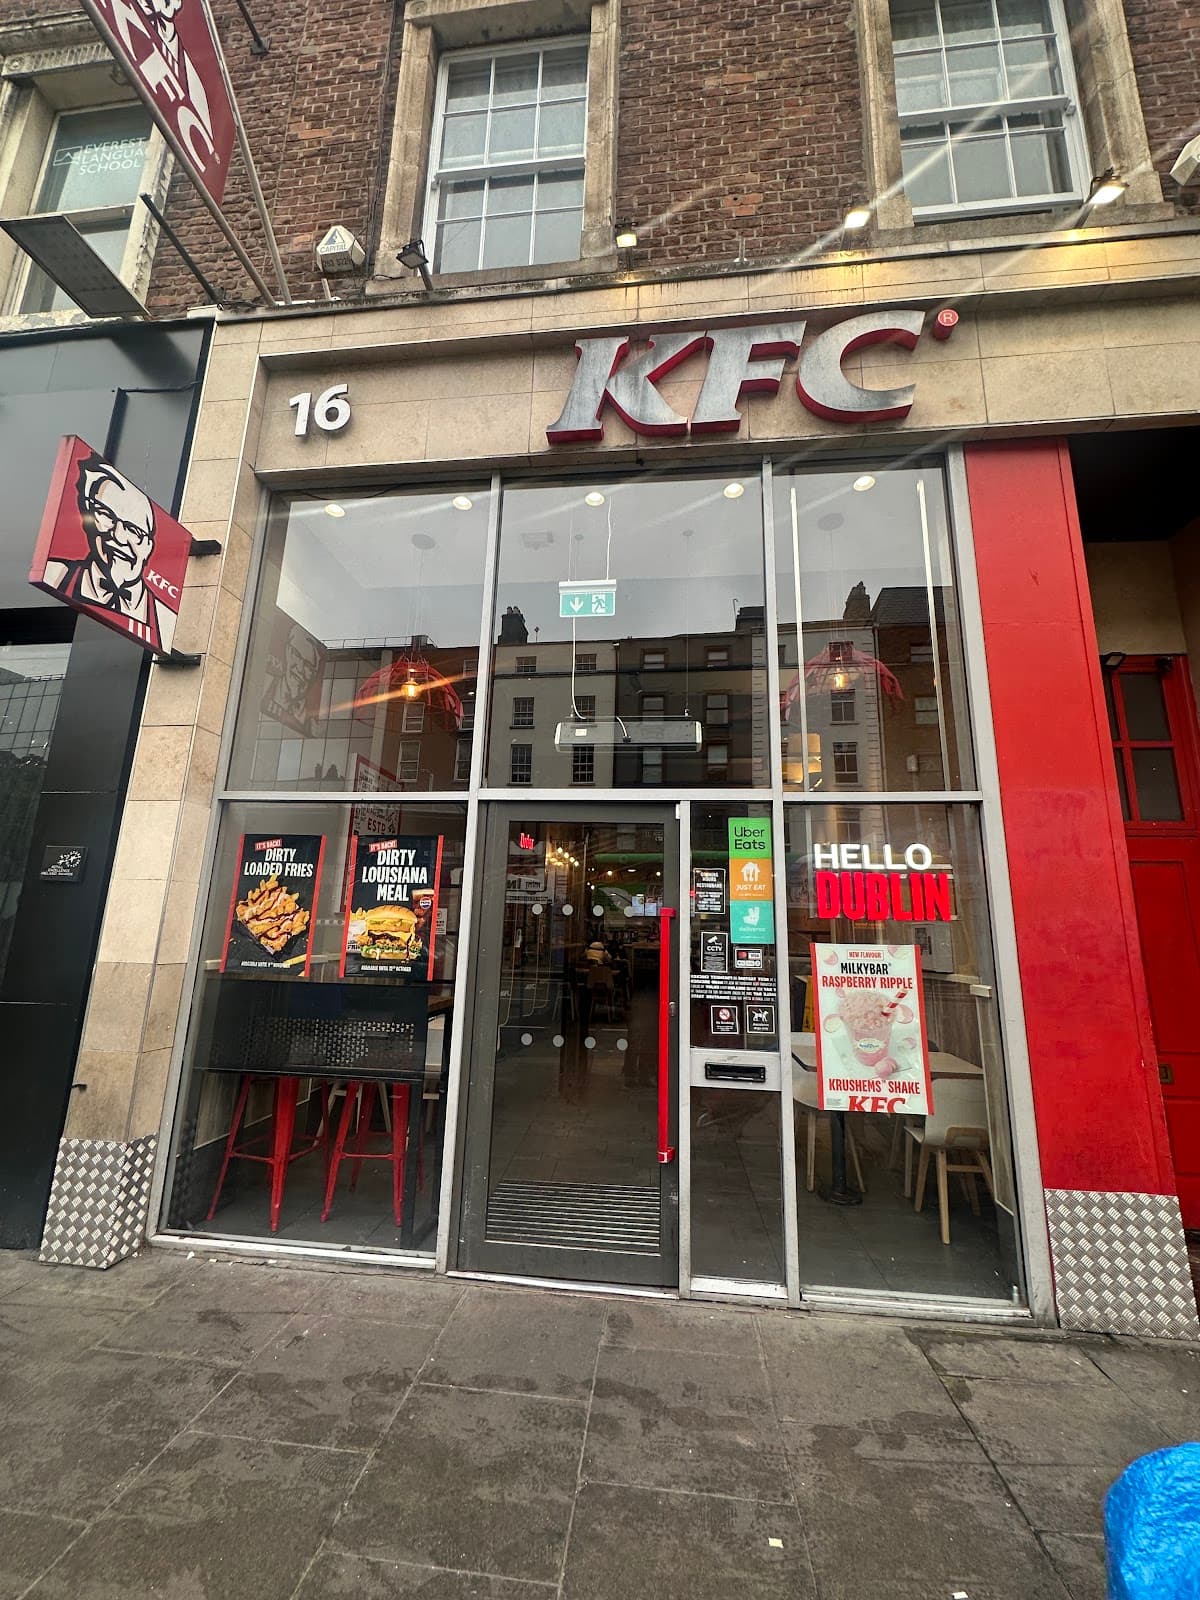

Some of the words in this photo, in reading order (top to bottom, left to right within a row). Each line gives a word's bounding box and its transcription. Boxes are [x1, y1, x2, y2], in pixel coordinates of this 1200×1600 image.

[84, 136, 147, 154] EVEREST
[82, 148, 145, 164] LANGUA
[79, 159, 142, 176] SCHOOL
[320, 244, 347, 253] CAPITAL
[546, 310, 926, 443] KFC
[289, 384, 350, 436] 16
[146, 569, 179, 599] KFC
[734, 826, 765, 837] Uber
[734, 839, 766, 850] Eats
[264, 848, 297, 862] DIRTY
[377, 849, 416, 866] DIRTY
[813, 842, 932, 870] HELLO
[243, 862, 283, 876] LOADED
[284, 863, 314, 877] FRIES
[361, 866, 428, 884] LOUISIANA
[376, 884, 410, 901] MEAL
[815, 869, 952, 922] DUBLIN
[840, 962, 889, 975] MILKYBAR
[822, 975, 877, 989] RASPBERRY
[880, 977, 913, 989] RIPPLE
[828, 1078, 882, 1093] KRUSHEMS
[888, 1080, 921, 1095] SHAKE
[848, 1095, 906, 1113] KFC
